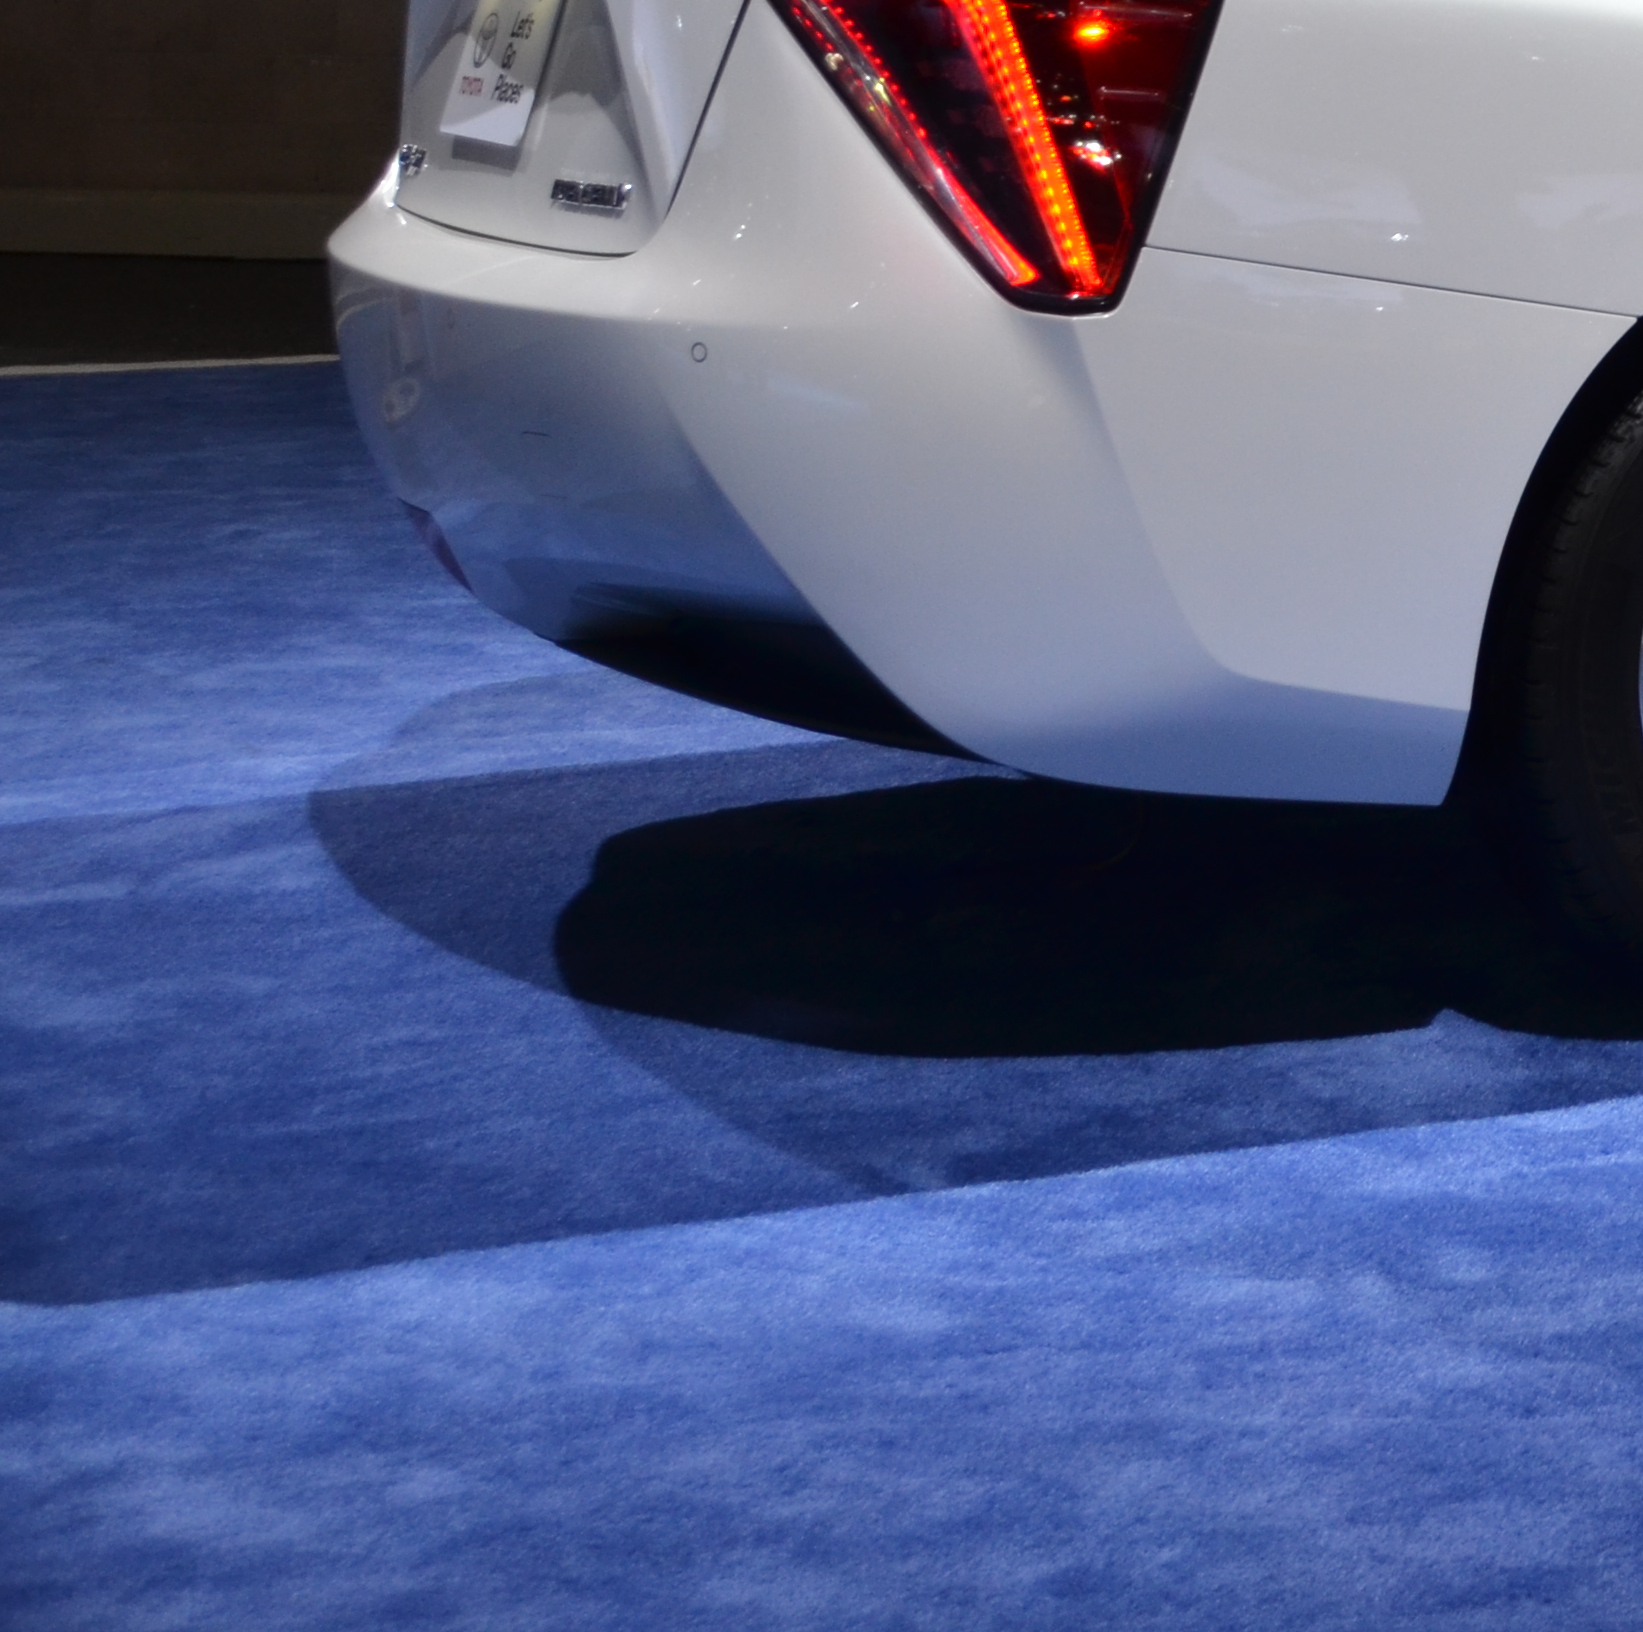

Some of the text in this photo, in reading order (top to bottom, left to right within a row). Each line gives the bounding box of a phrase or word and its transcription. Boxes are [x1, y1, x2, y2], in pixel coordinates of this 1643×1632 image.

[501, 42, 516, 69] Go
[461, 75, 484, 96] TOYOTA
[492, 73, 523, 104] Places
